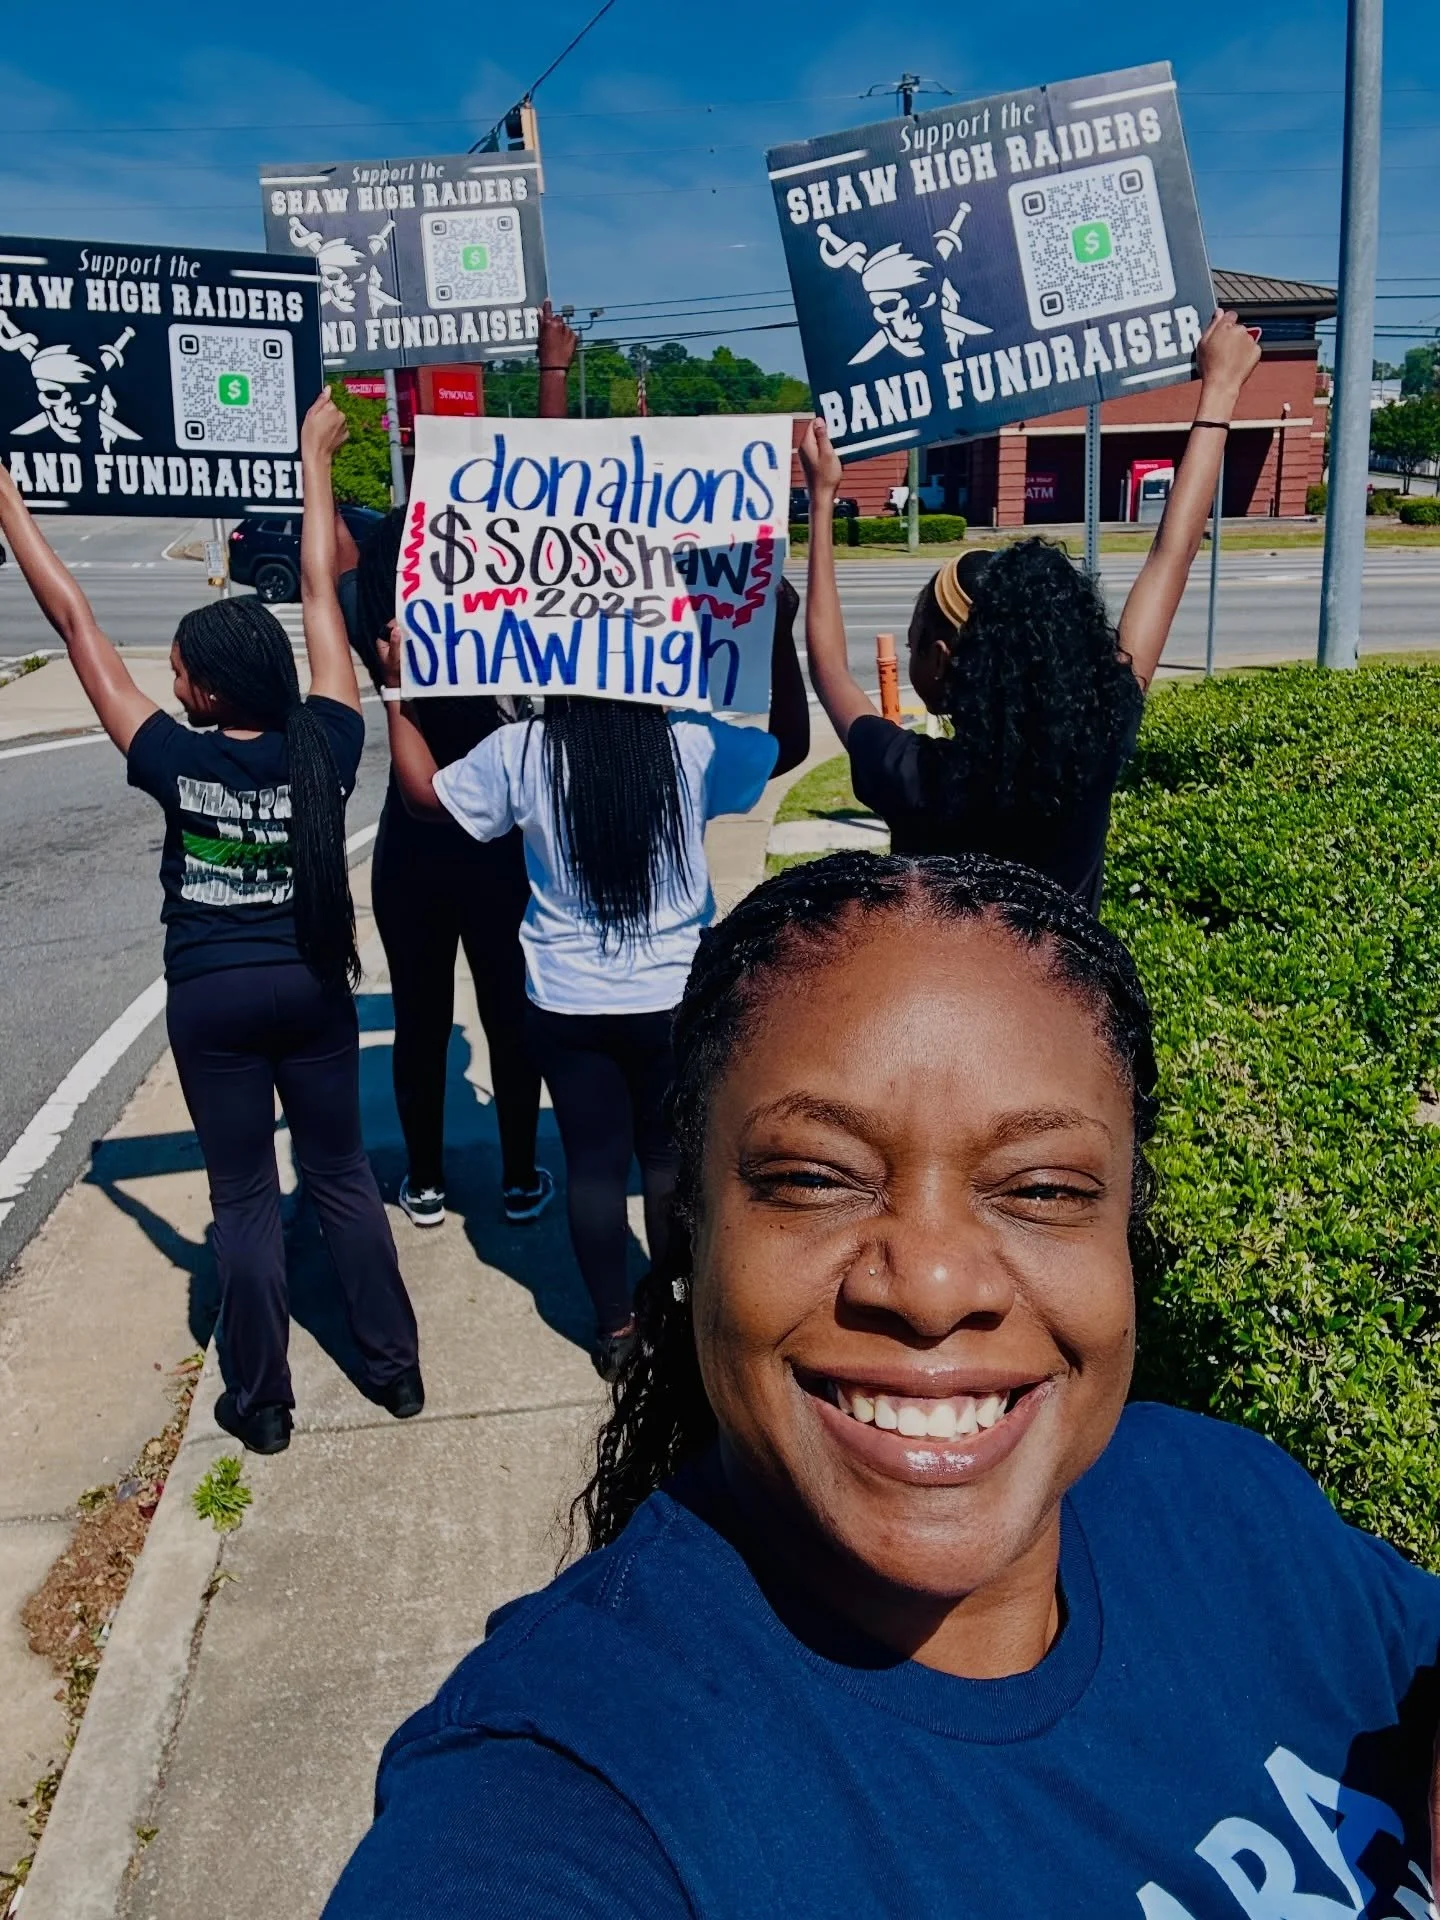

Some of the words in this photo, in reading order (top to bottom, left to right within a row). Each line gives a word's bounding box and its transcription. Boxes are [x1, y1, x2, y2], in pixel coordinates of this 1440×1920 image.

[900, 107, 992, 153] Support
[1001, 102, 1035, 130] the
[352, 163, 414, 186] Support
[420, 162, 445, 180] the
[785, 164, 897, 225] SHAW
[910, 142, 997, 196] HIGH
[1005, 106, 1162, 173] RAIDERS
[270, 188, 349, 216] SHAW
[357, 184, 416, 212] HIGH
[422, 177, 528, 208] RAIDERS
[78, 249, 161, 279] Support
[170, 255, 200, 278] the
[86, 278, 161, 315] HIGH
[171, 283, 304, 322] RAIDERS
[322, 320, 357, 354] ND
[365, 307, 540, 350] FUNDRAISER
[819, 369, 934, 439] BAND
[941, 304, 1202, 411] FUNDRAISER
[8, 451, 83, 493] AND
[450, 433, 779, 528] donations
[1025, 487, 1054, 499] ATM
[533, 587, 666, 628] 2025
[177, 775, 257, 819] WHAT
[258, 784, 292, 819] PA
